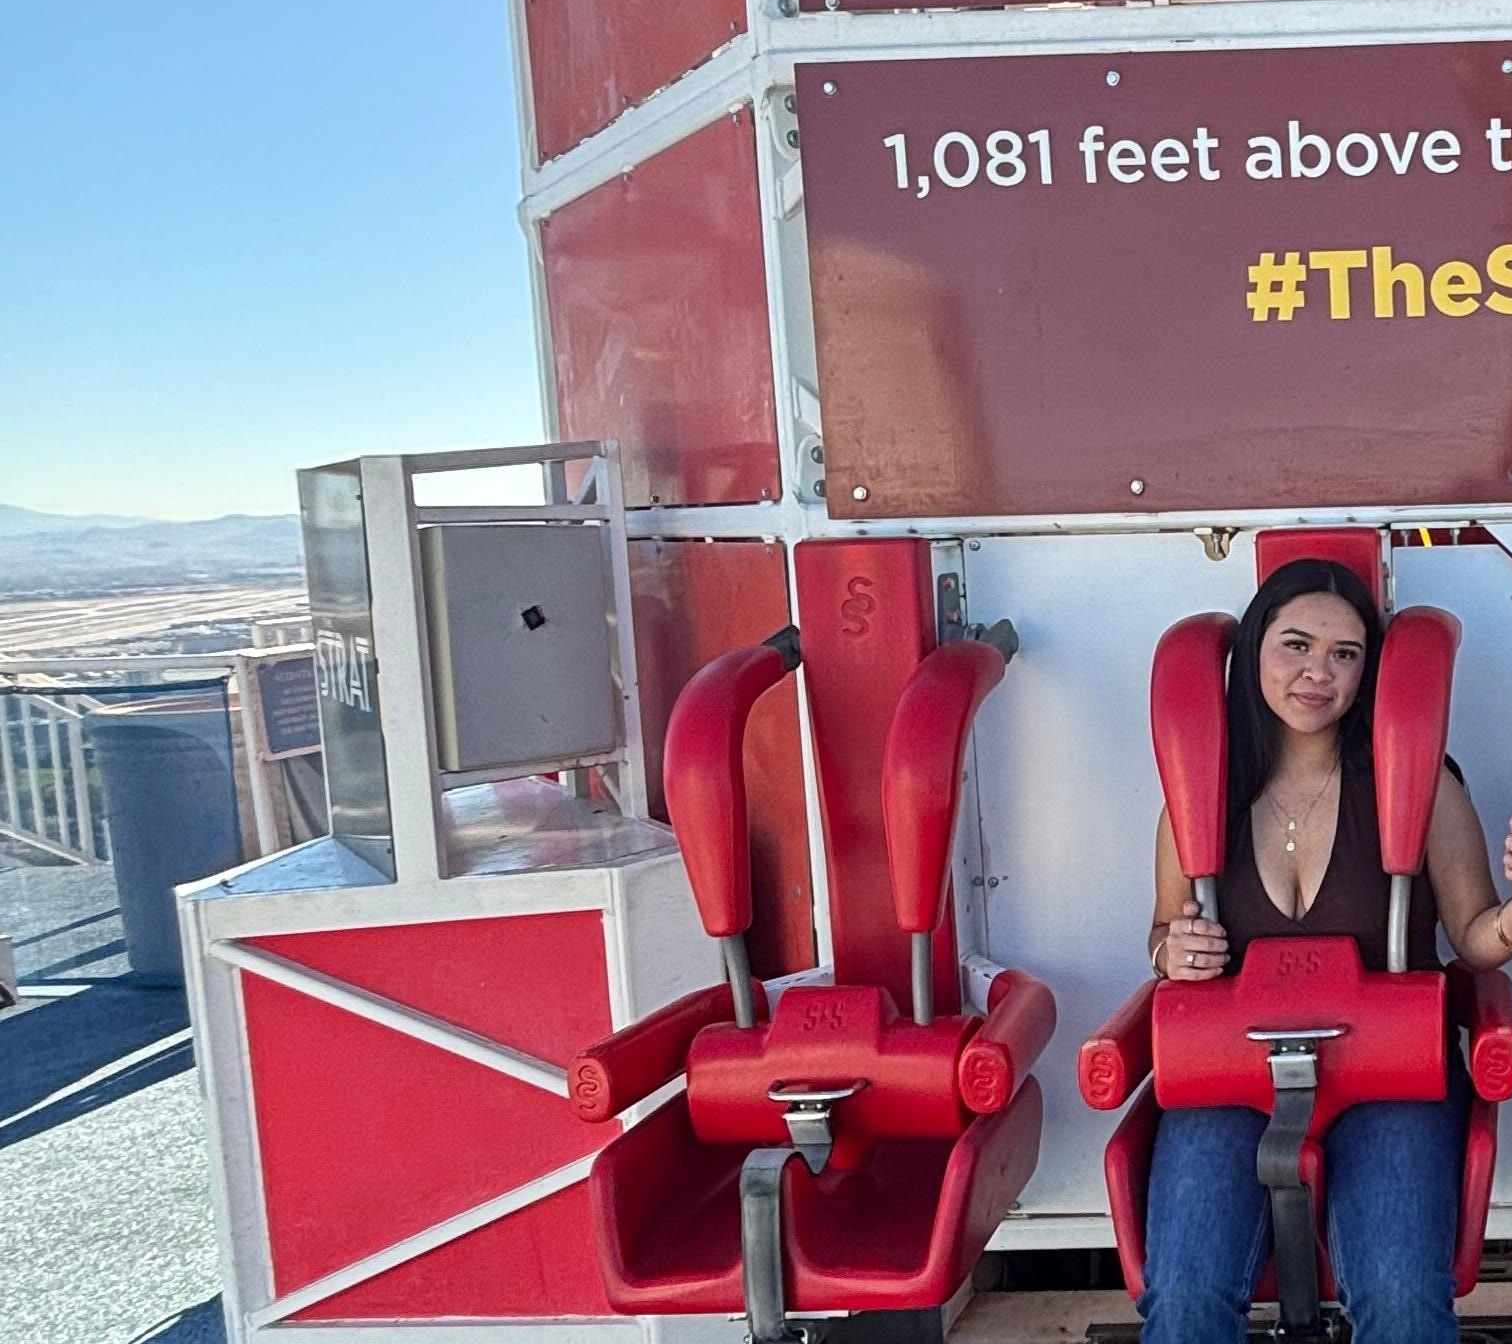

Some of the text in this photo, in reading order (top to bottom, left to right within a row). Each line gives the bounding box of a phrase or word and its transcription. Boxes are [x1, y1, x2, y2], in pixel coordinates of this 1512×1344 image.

[883, 128, 1053, 199] 1,081
[1078, 125, 1221, 184] feet
[1245, 120, 1461, 180] above
[316, 628, 371, 713] STRAT
